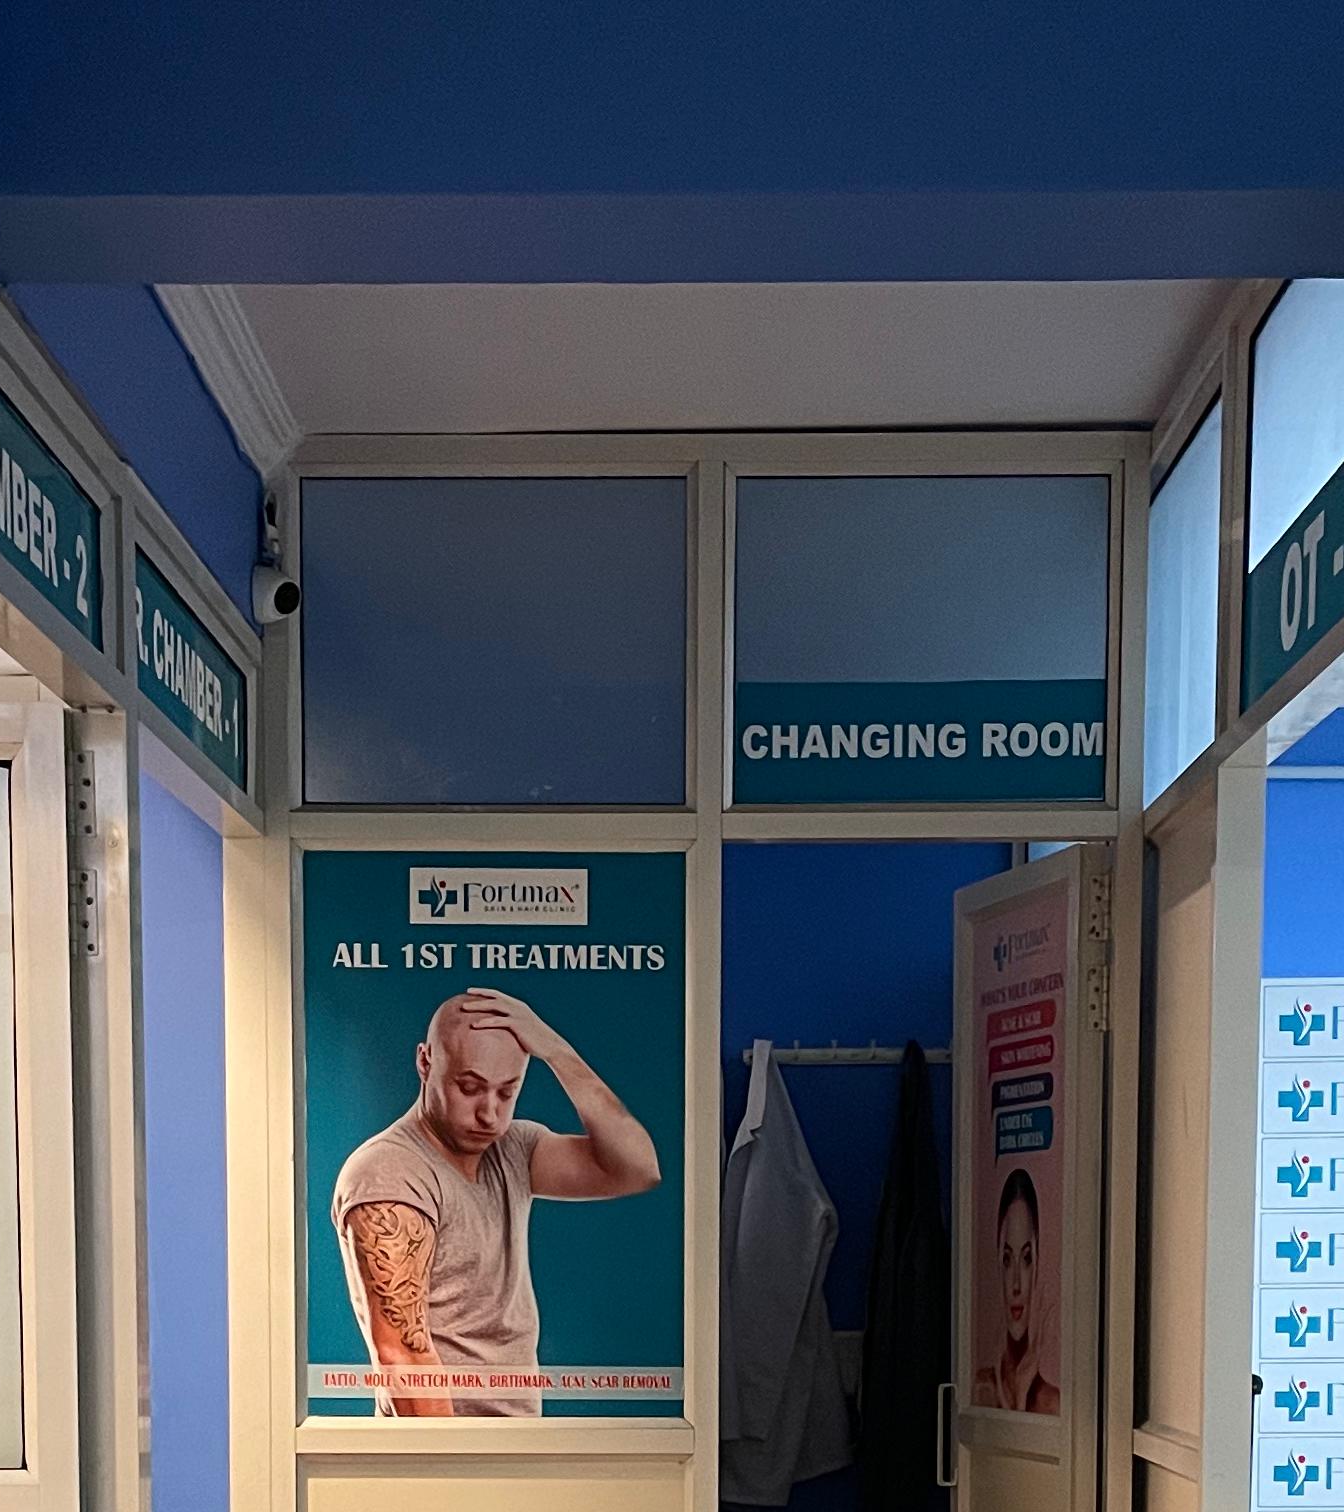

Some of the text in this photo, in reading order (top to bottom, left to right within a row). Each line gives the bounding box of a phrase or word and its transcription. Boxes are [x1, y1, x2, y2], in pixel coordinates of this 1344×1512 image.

[75, 534, 89, 619] 2
[1280, 510, 1325, 651] OT
[153, 609, 223, 742] CHAMBER
[232, 698, 240, 758] 1
[742, 722, 1104, 759] CHANGING ROOM
[463, 882, 575, 912] Fortmax
[332, 943, 665, 971] ALL 1ST TREATMENTS
[400, 1373, 448, 1387] STRETCH
[561, 1374, 586, 1388] ACNE
[591, 1375, 619, 1389] SCAR
[622, 1375, 672, 1389] REMOVAL
